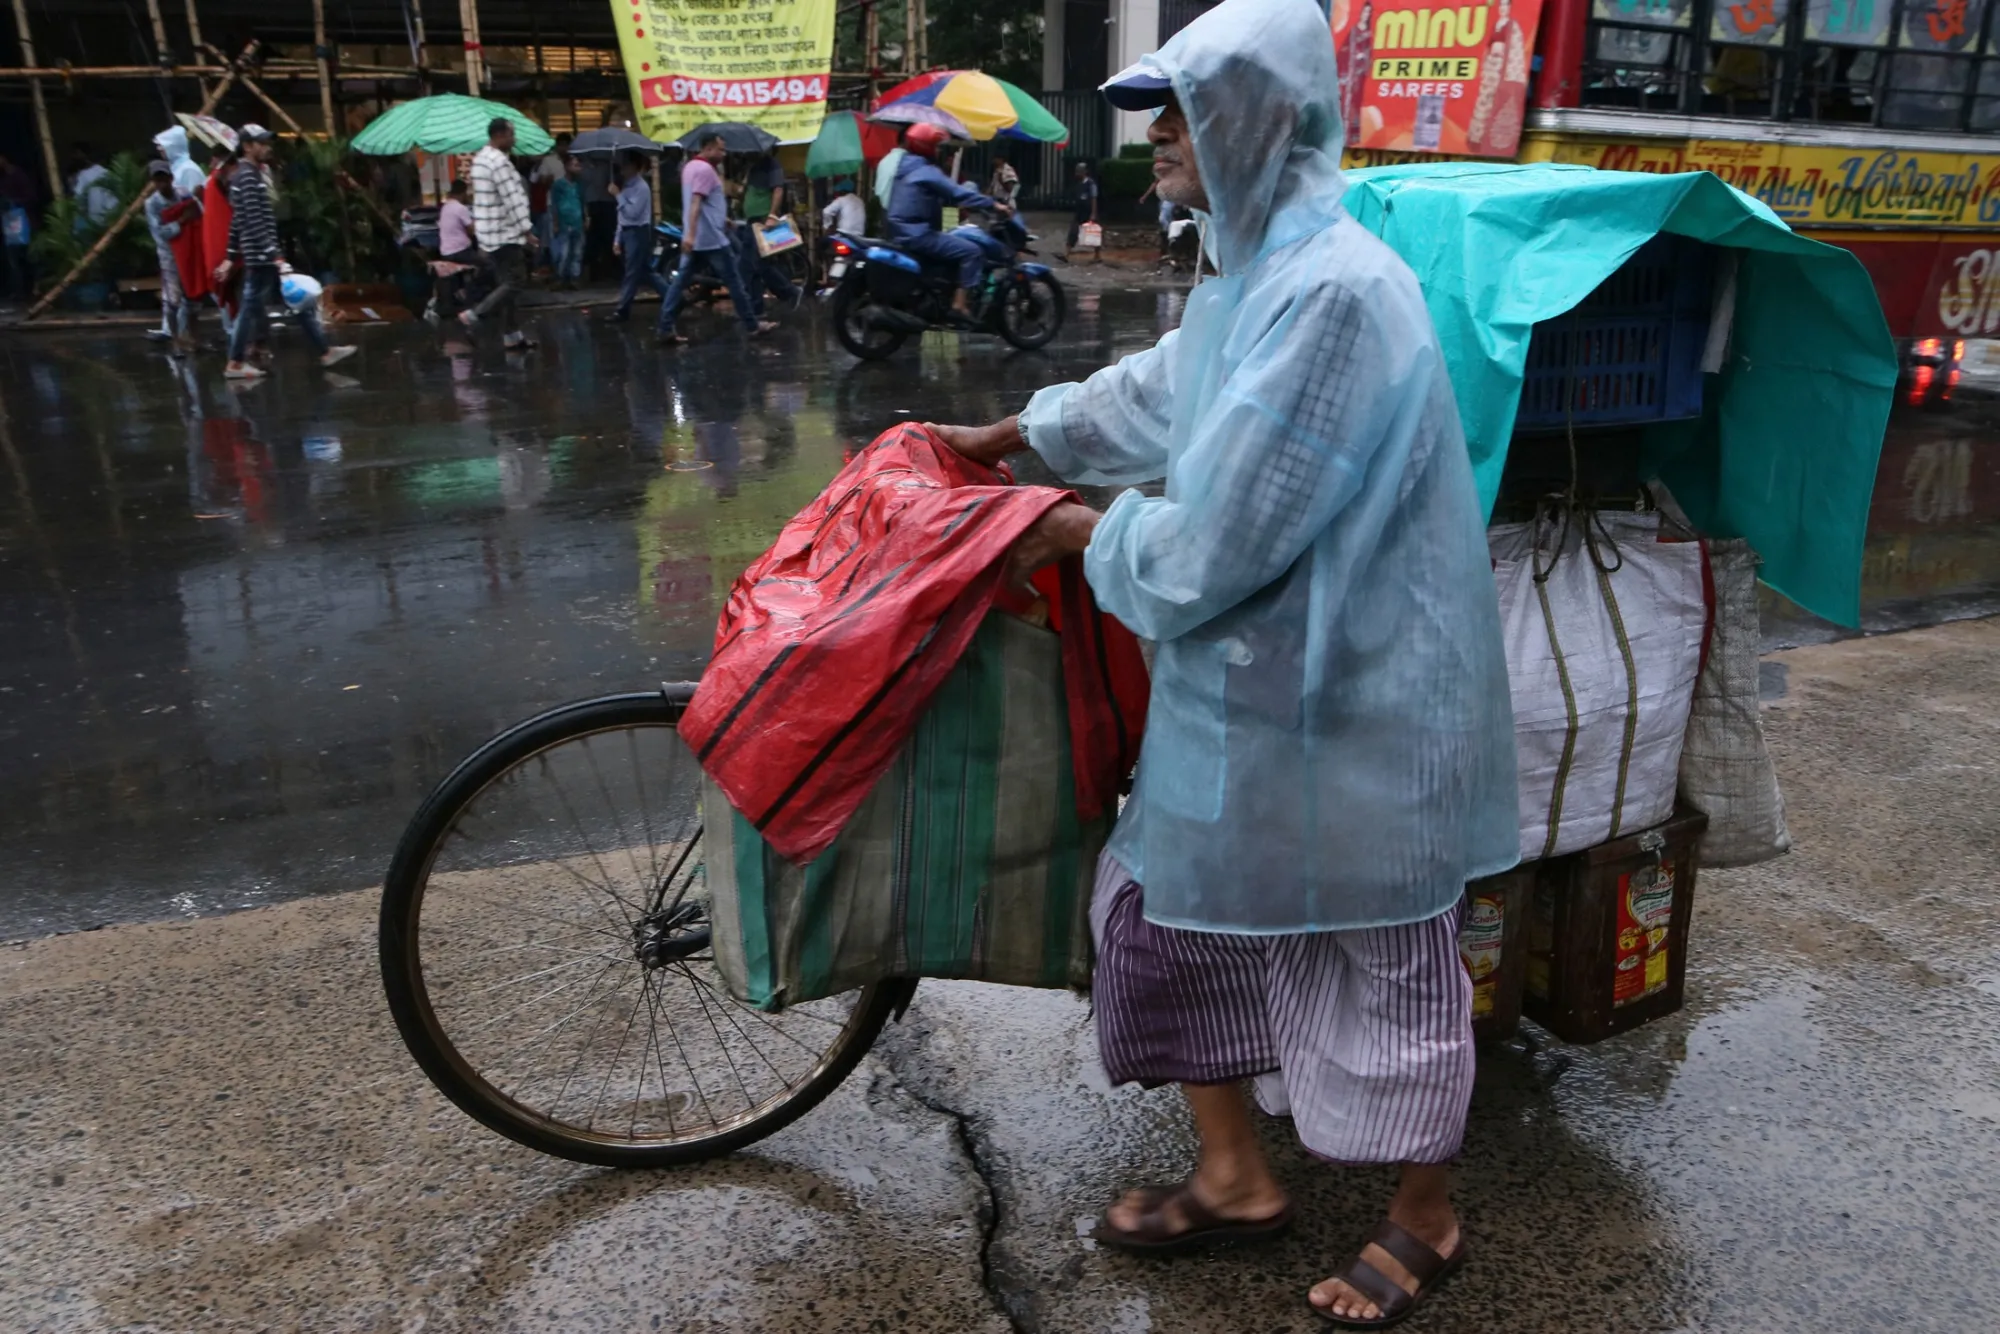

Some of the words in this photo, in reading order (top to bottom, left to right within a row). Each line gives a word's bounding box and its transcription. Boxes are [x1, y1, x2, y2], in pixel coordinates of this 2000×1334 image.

[724, 14, 739, 25] 30
[1378, 60, 1470, 77] PRIME
[672, 77, 824, 104] 9147415494
[1378, 82, 1464, 98] SAREES
